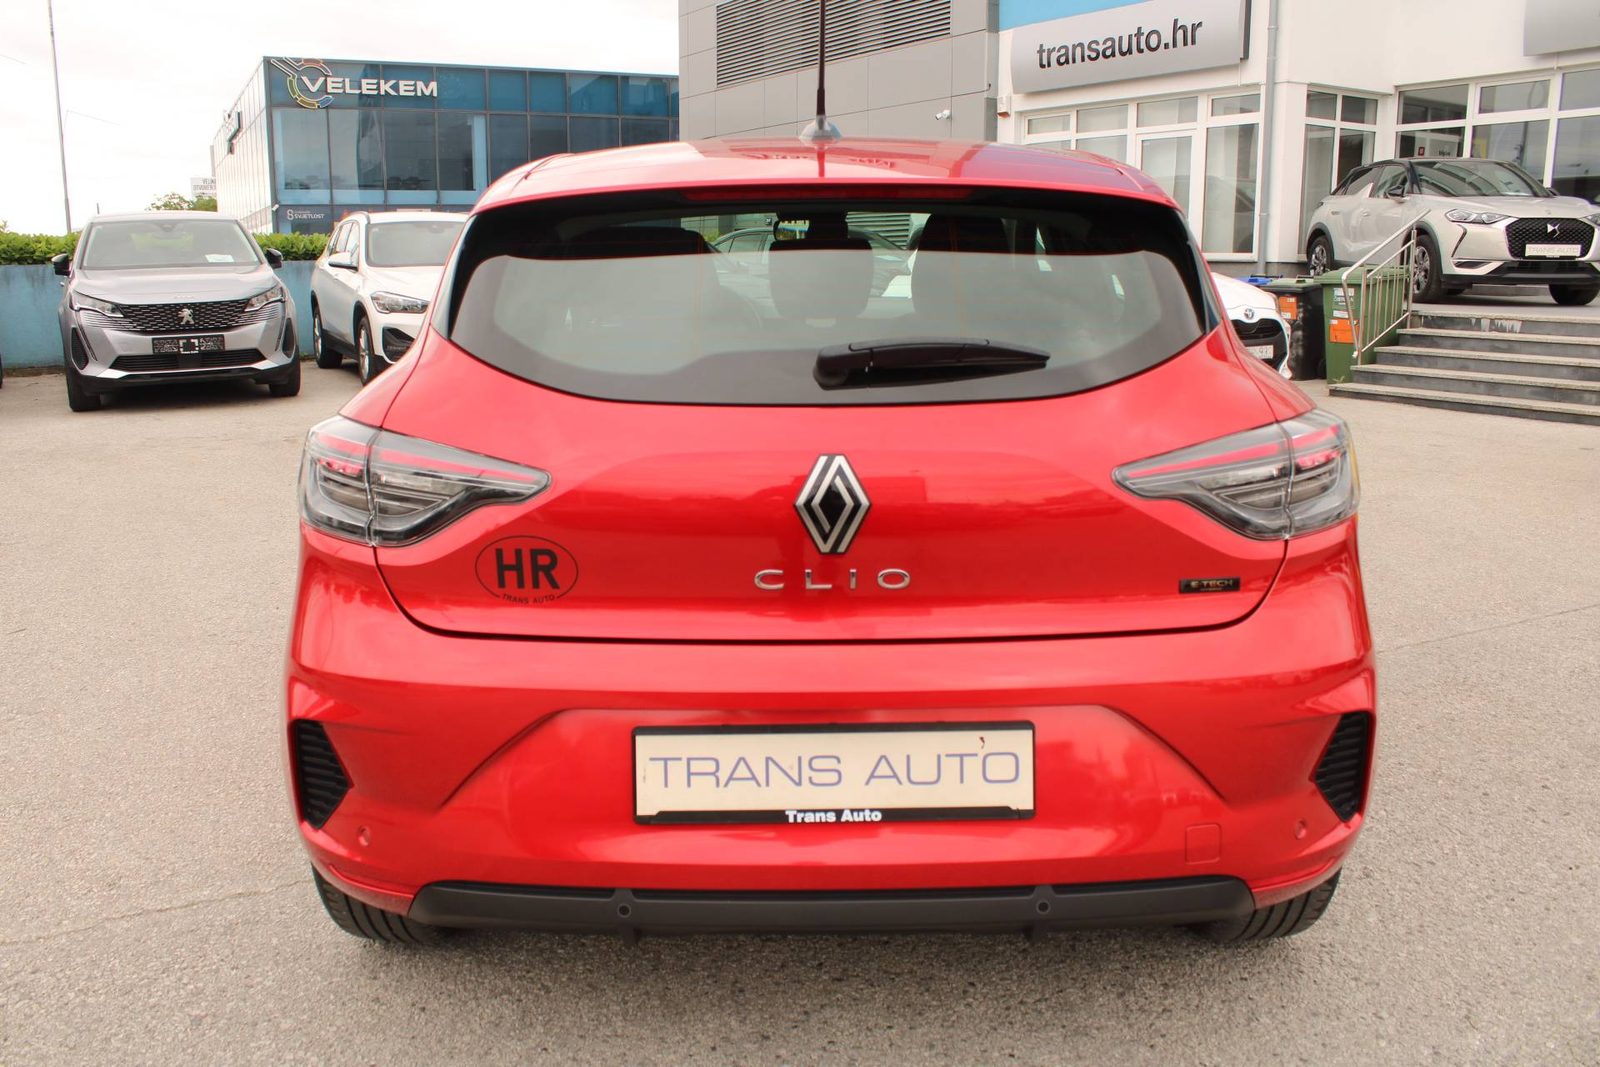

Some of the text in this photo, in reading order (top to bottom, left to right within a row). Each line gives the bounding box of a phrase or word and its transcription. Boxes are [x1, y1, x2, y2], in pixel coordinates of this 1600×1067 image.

[1037, 18, 1203, 69] transauto.hr
[301, 75, 438, 97] VELEKEM
[495, 548, 560, 589] HR
[754, 568, 911, 590] CLIO
[503, 593, 556, 605] TRANS AUTO
[649, 751, 1020, 788] TRANS AUTO
[785, 808, 882, 823] Trans Auto
